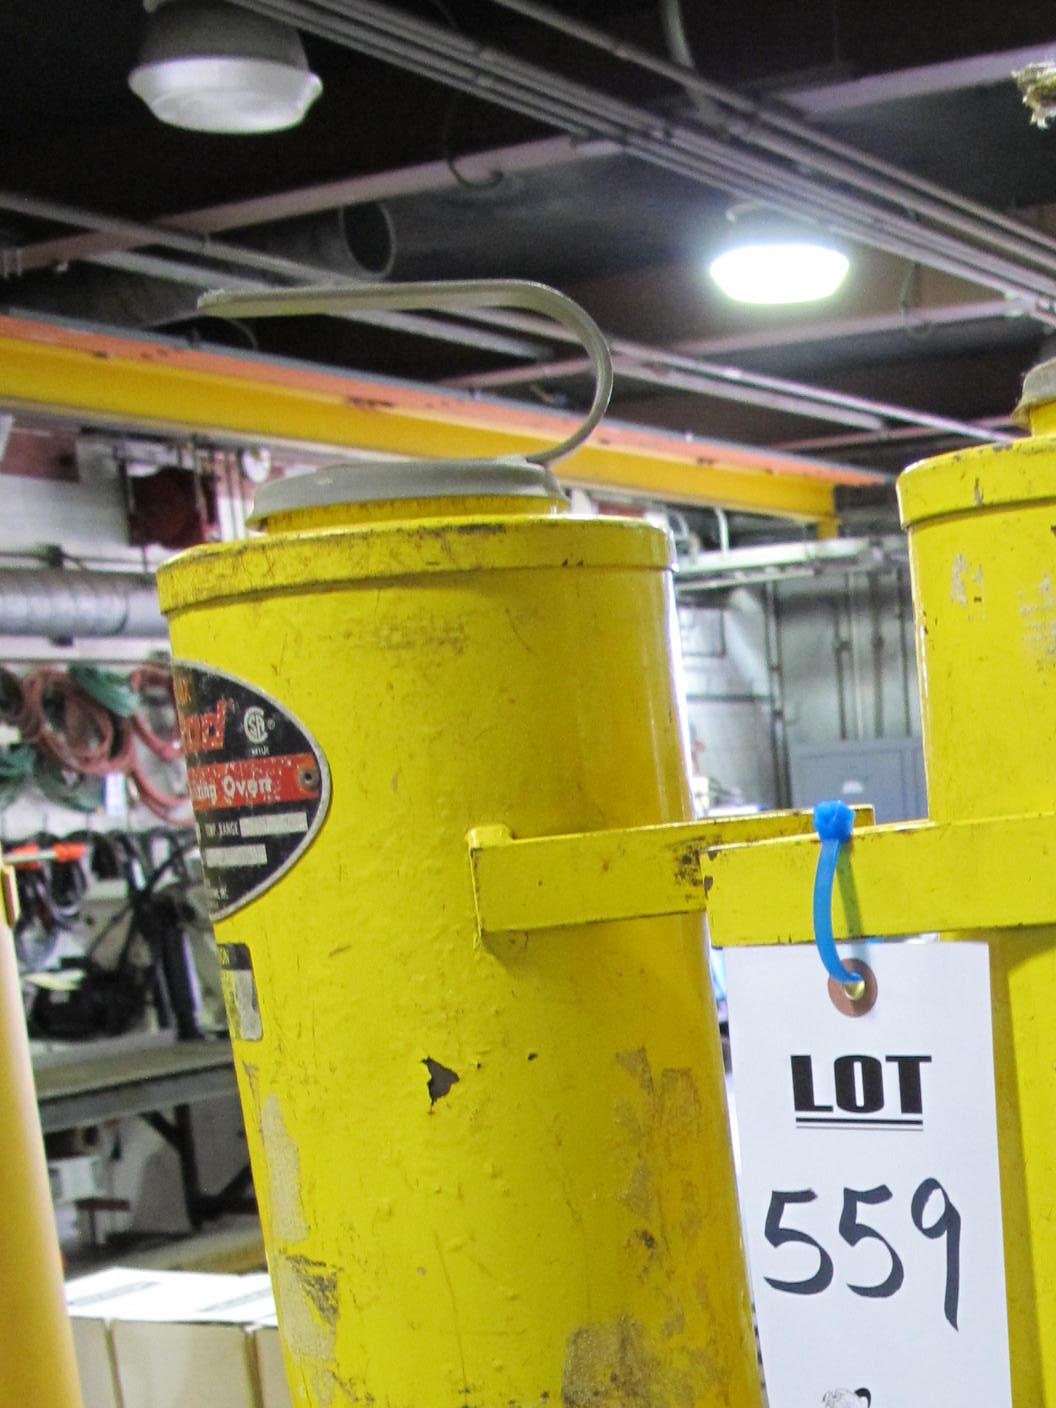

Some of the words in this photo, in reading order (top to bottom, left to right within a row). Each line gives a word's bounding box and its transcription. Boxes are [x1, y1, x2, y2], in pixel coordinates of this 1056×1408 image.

[223, 775, 272, 798] Oven
[790, 1054, 932, 1114] LOT
[763, 1177, 961, 1333] 559
